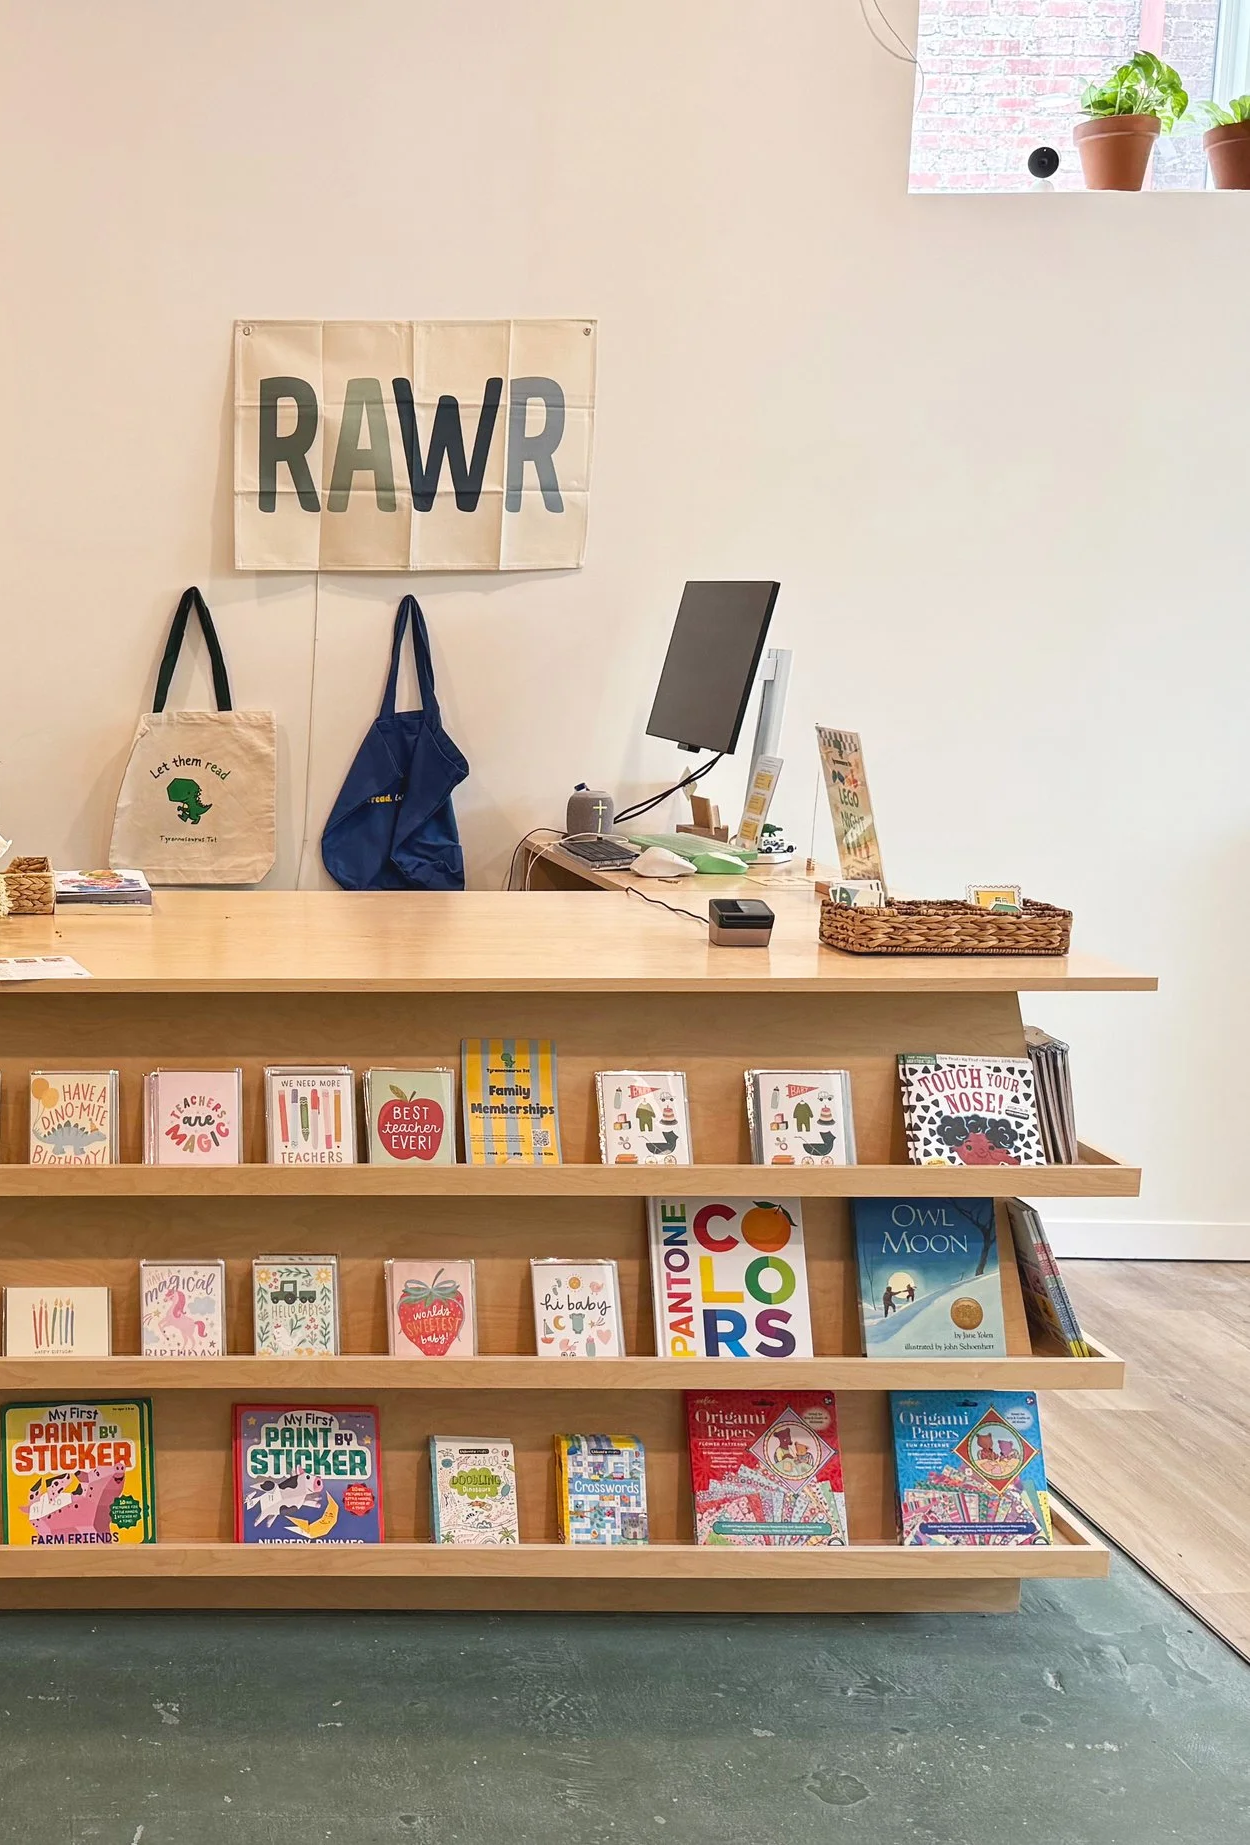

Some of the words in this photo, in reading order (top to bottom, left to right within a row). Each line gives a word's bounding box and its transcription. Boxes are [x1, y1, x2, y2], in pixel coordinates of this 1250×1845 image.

[258, 376, 566, 513] RAWR
[150, 762, 169, 778] Let
[172, 755, 201, 767] them
[205, 762, 231, 780] read
[839, 788, 859, 808] LEGO
[281, 1080, 294, 1088] WE
[918, 1068, 983, 1096] TOUCH
[987, 1074, 1019, 1093] YOUR
[62, 1083, 97, 1102] HAVE
[98, 1089, 107, 1103] A
[489, 1085, 530, 1099] Family
[171, 1096, 227, 1119] TEACHERS
[471, 1103, 554, 1118] Memberships
[944, 1092, 1003, 1115] NOSE!
[42, 1103, 108, 1131] DINO-MITE
[183, 1113, 215, 1127] are
[393, 1106, 428, 1120] BEST
[382, 1121, 440, 1135] teacher
[165, 1121, 229, 1153] MAGIC
[392, 1135, 432, 1150] EVER!
[281, 1150, 343, 1164] TEACHERS
[892, 1204, 954, 1227] OWL
[882, 1231, 968, 1253] MOON
[661, 1204, 696, 1357] PANTONE
[145, 1273, 215, 1306] magical
[272, 1305, 295, 1319] HELLO
[298, 1304, 320, 1317] BABY
[540, 1293, 564, 1311] hi
[567, 1296, 611, 1315] baby
[413, 1305, 451, 1320] world's
[406, 1317, 461, 1336] SWEETEST
[421, 1332, 449, 1345] baby!
[962, 1331, 975, 1339] Jane
[976, 1331, 994, 1339] Yolen
[935, 1343, 942, 1351] by
[943, 1343, 958, 1351] John
[49, 1409, 67, 1422] My
[70, 1408, 98, 1421] First
[284, 1414, 303, 1426] My
[306, 1413, 334, 1426] First
[695, 1409, 765, 1424] Origami
[899, 1412, 969, 1426] Origami
[30, 1422, 96, 1444] PAINT
[99, 1425, 118, 1439] BY
[265, 1427, 332, 1447] PAINT
[334, 1433, 353, 1446] BY
[707, 1424, 755, 1440] Papers
[912, 1427, 959, 1441] Papers
[15, 1442, 133, 1472] STICKER
[251, 1449, 368, 1476] STICKER
[452, 1475, 501, 1485] DOODLING
[574, 1481, 639, 1493] Crosswords
[31, 1534, 64, 1544] FARM
[68, 1532, 119, 1544] FRIENDS
